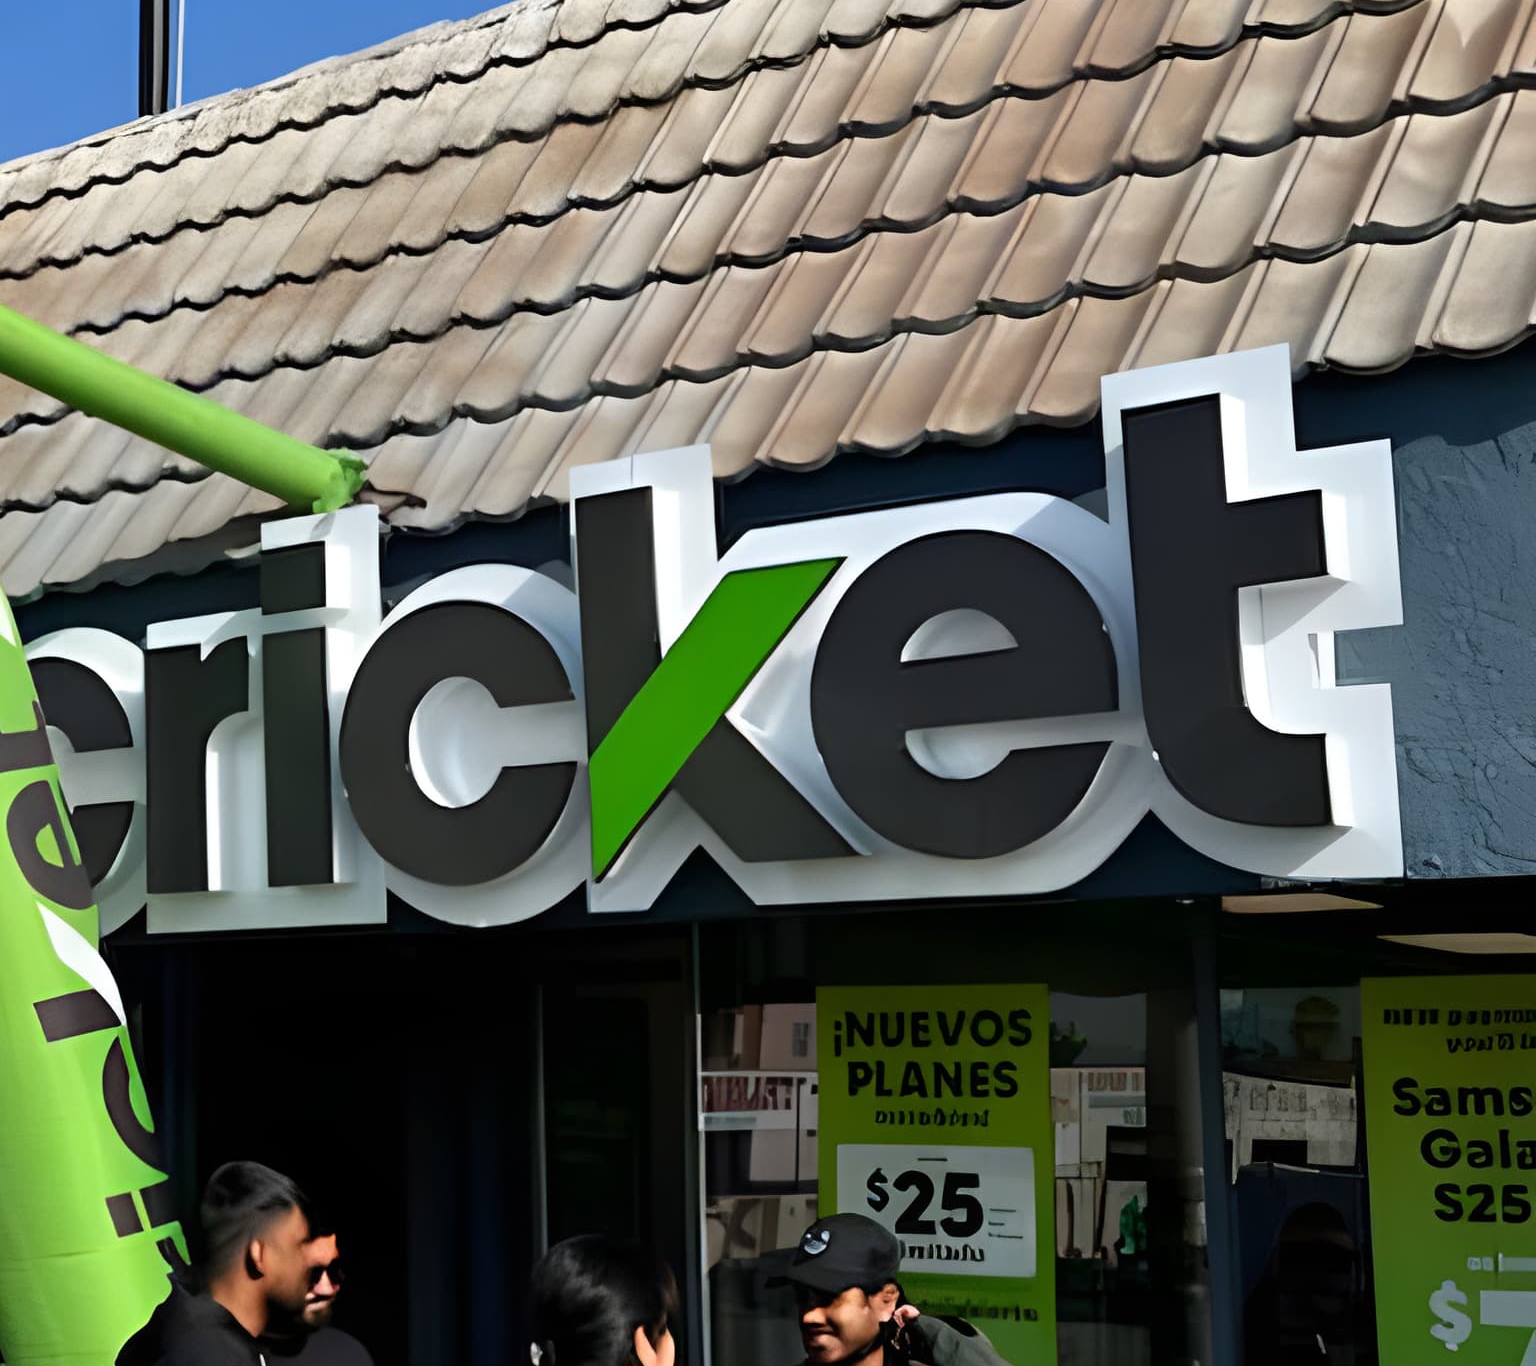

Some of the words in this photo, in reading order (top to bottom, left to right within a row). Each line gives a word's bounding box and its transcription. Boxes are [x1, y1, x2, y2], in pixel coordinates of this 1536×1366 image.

[25, 392, 1334, 895] cricket
[847, 1060, 1019, 1099] PLANES
[866, 1167, 985, 1239] $25
